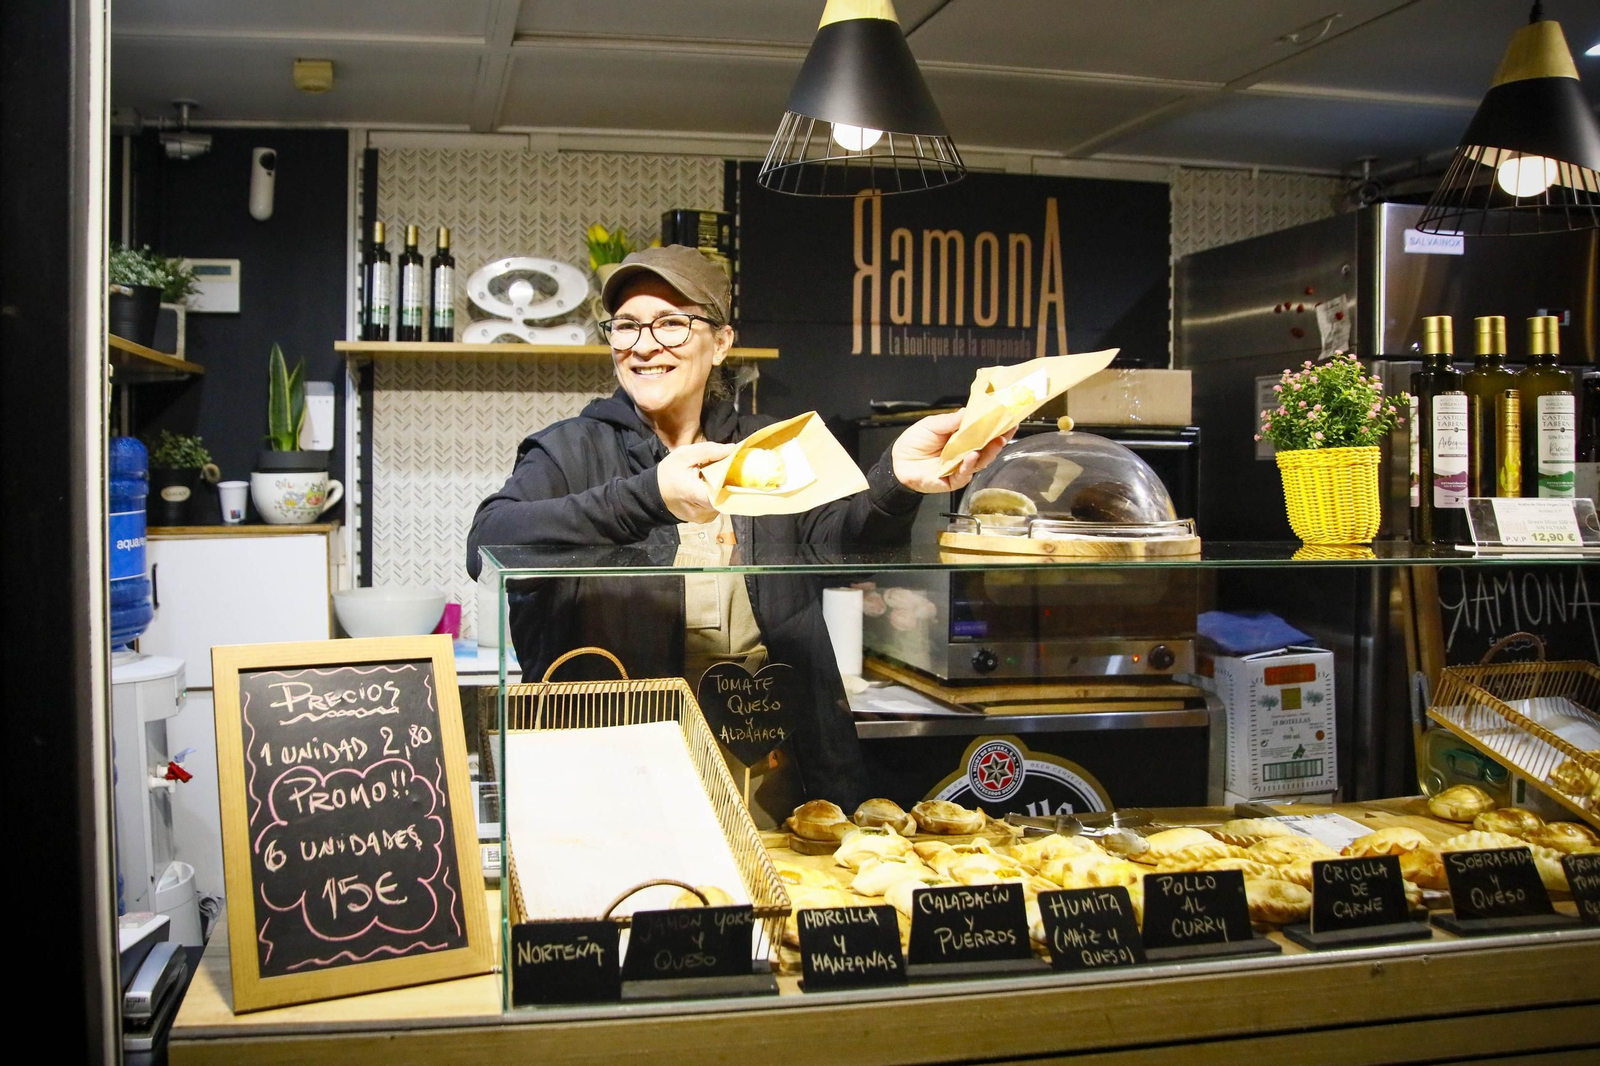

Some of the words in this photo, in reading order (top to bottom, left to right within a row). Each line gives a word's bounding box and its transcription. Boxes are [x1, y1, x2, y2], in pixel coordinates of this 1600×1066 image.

[1410, 236, 1462, 247] SALVAINOX
[904, 326, 949, 363] boutique
[952, 328, 964, 356] de
[968, 328, 977, 356] la
[981, 329, 1031, 364] empanada
[1531, 533, 1564, 542] 12,90
[1567, 533, 1576, 541] €
[709, 674, 774, 695] TOMATE
[260, 743, 272, 766] 1
[281, 737, 368, 764] UNIDAD
[264, 840, 287, 872] 6
[301, 824, 423, 861] UNIDADES
[1322, 861, 1389, 884] CRIOLLA
[1350, 882, 1369, 896] DE
[1049, 891, 1123, 919] HUMITA
[1181, 896, 1206, 915] AL
[1332, 897, 1384, 918] CARNE
[714, 911, 755, 936] YORK
[517, 936, 604, 966] NORTEÑA
[934, 927, 1017, 954] PUERROS
[812, 951, 898, 976] MANZANAS
